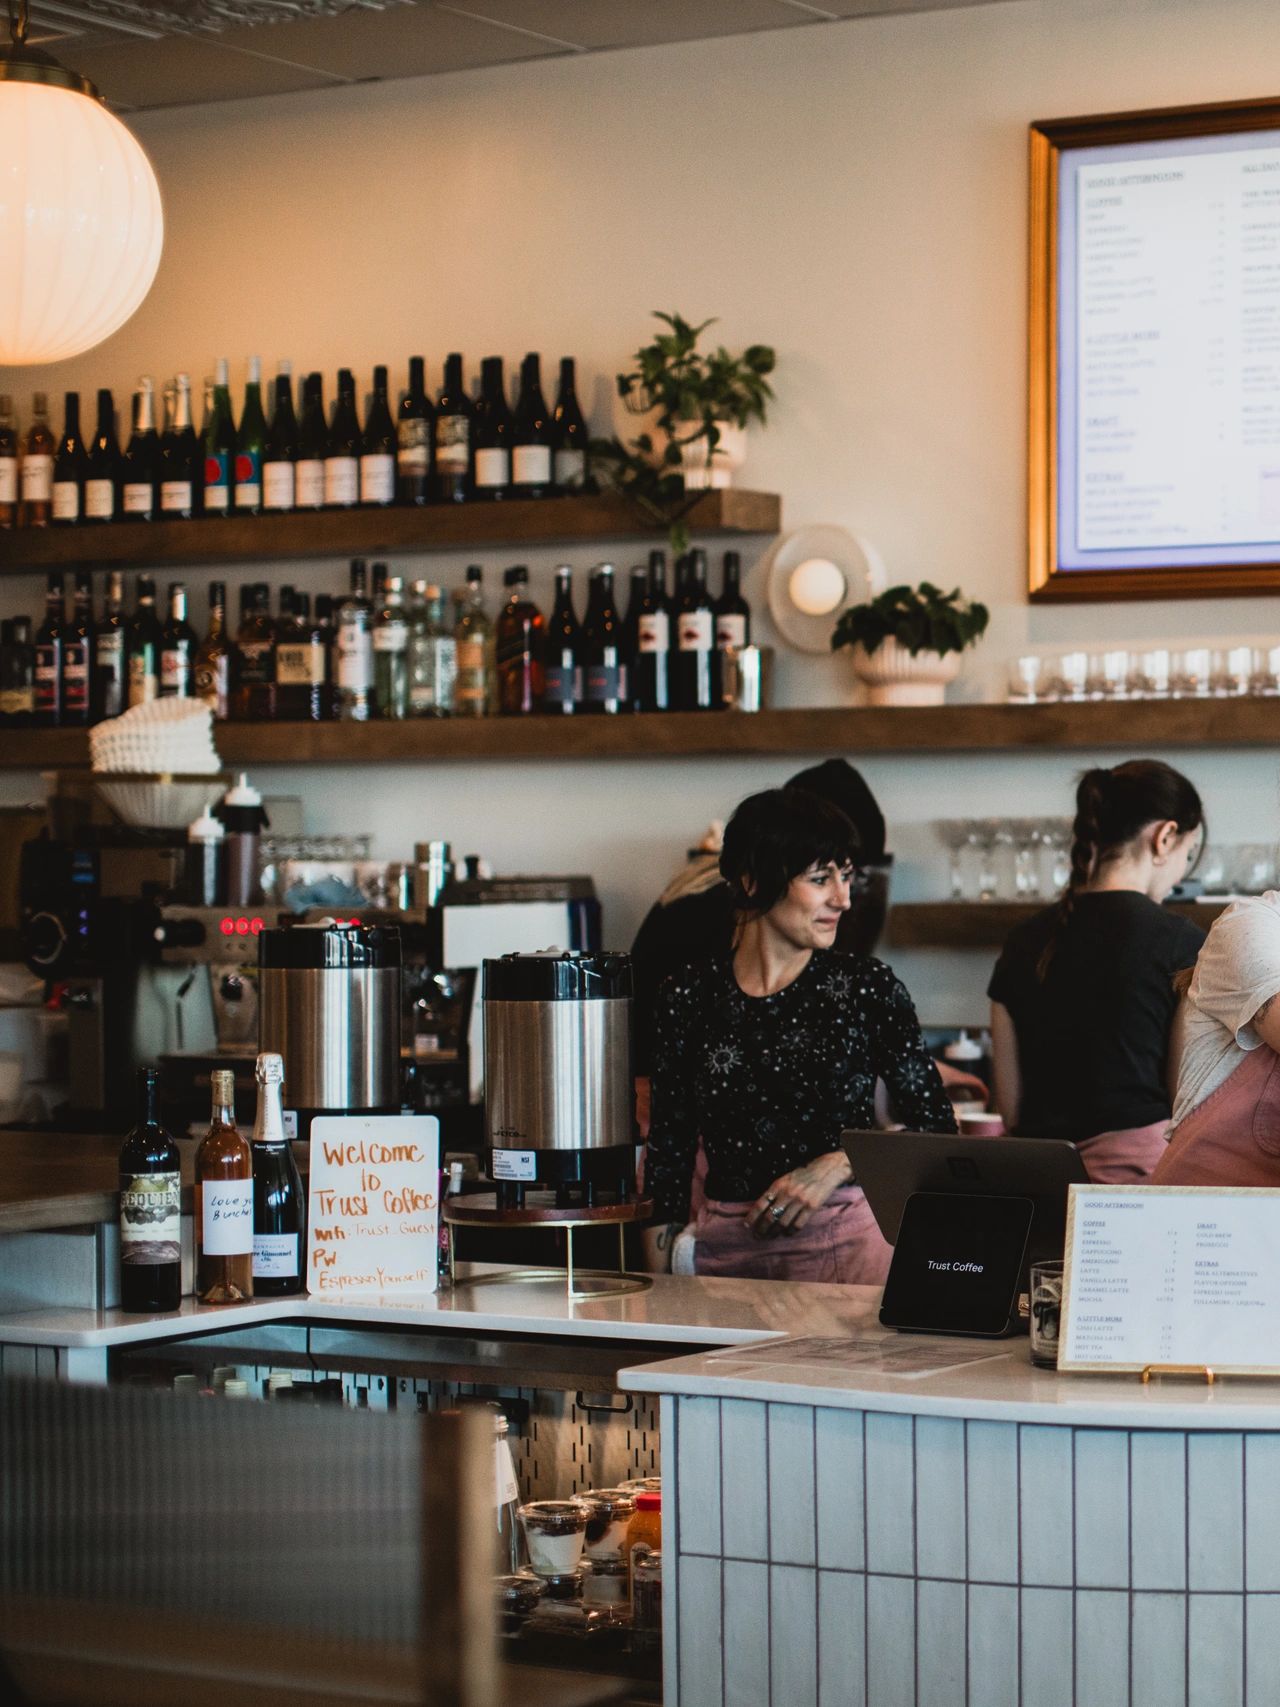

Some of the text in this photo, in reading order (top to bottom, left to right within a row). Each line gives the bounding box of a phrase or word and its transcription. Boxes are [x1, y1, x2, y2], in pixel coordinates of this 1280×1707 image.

[323, 1141, 424, 1166] Welcome
[314, 1188, 437, 1216] Trust Coffee
[928, 1260, 984, 1273] Trust Coffee
